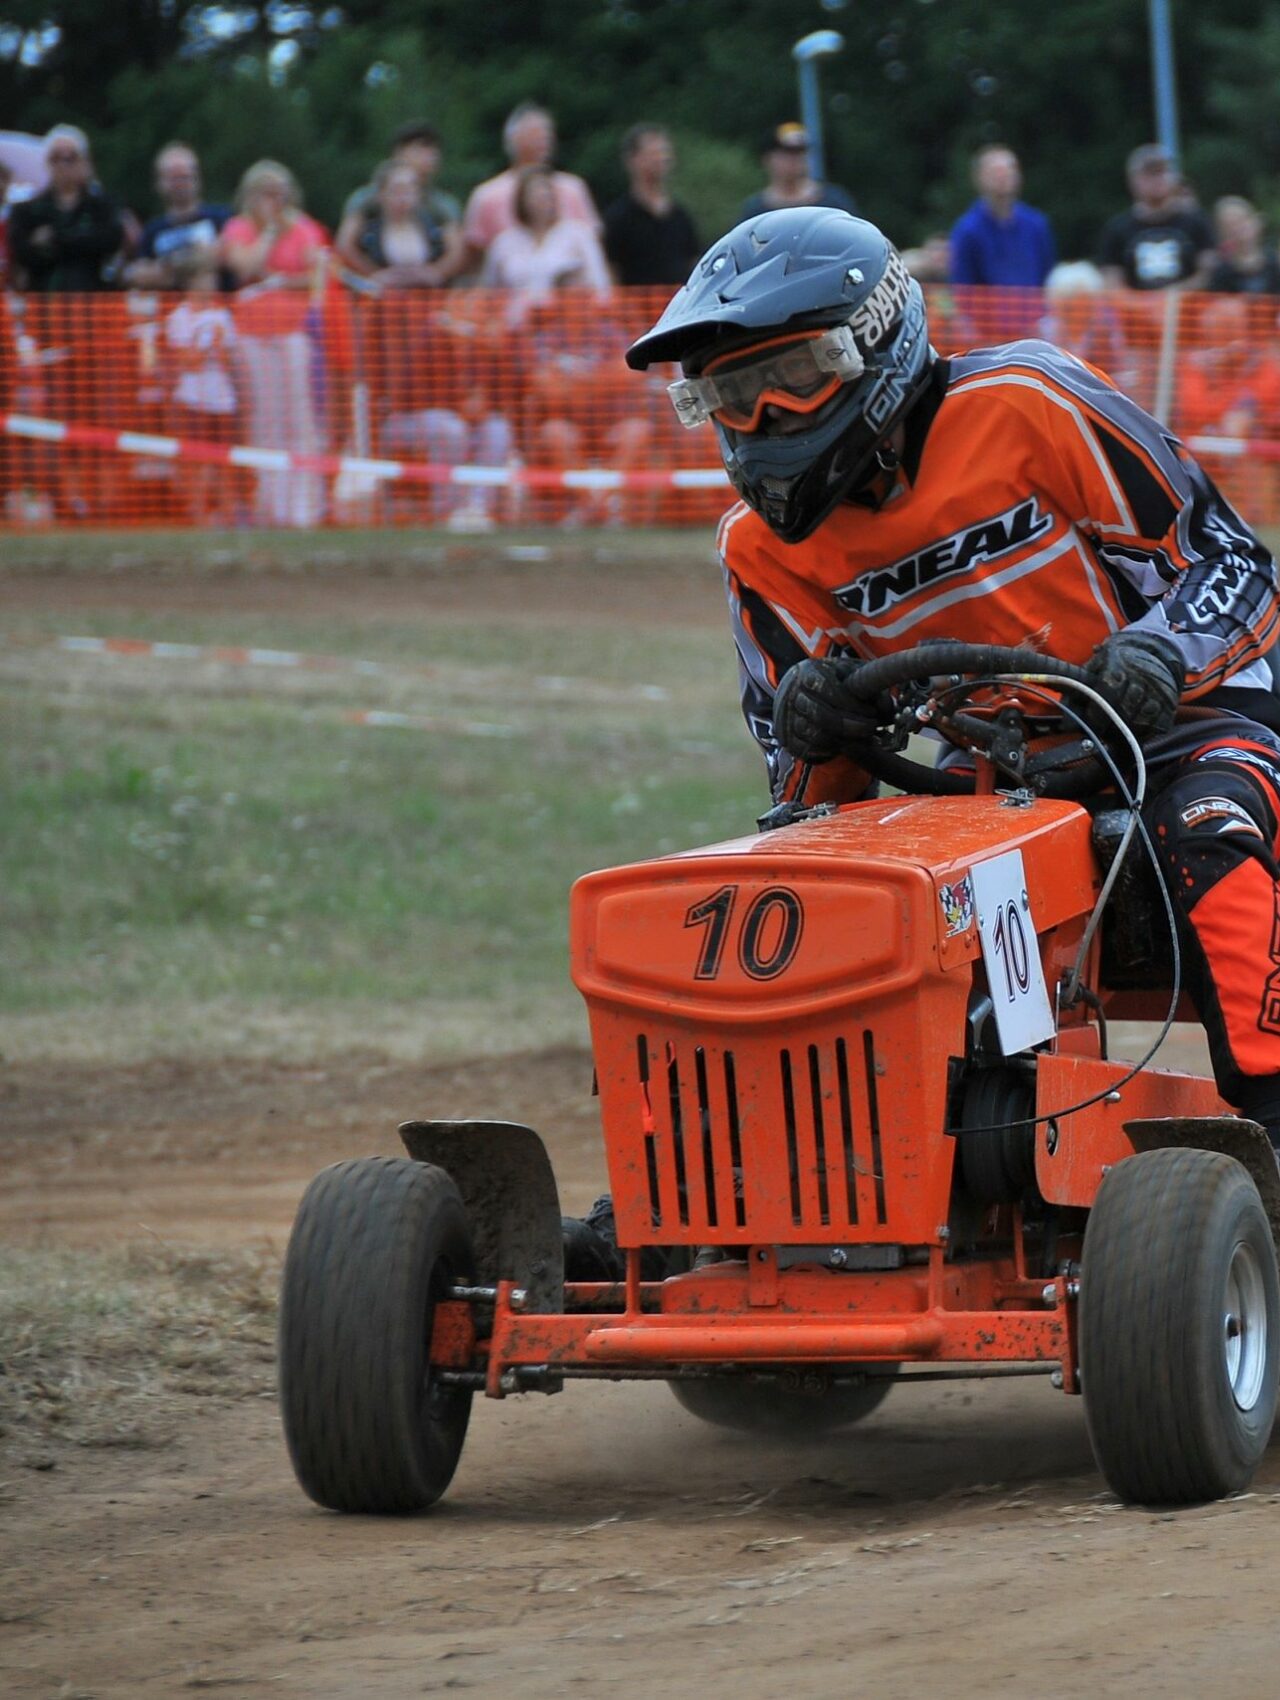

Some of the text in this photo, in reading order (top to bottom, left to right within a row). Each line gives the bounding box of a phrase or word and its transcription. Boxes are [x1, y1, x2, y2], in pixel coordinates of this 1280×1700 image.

[848, 252, 905, 336] SMITH
[683, 885, 804, 981] 10
[993, 899, 1030, 1003] 10
